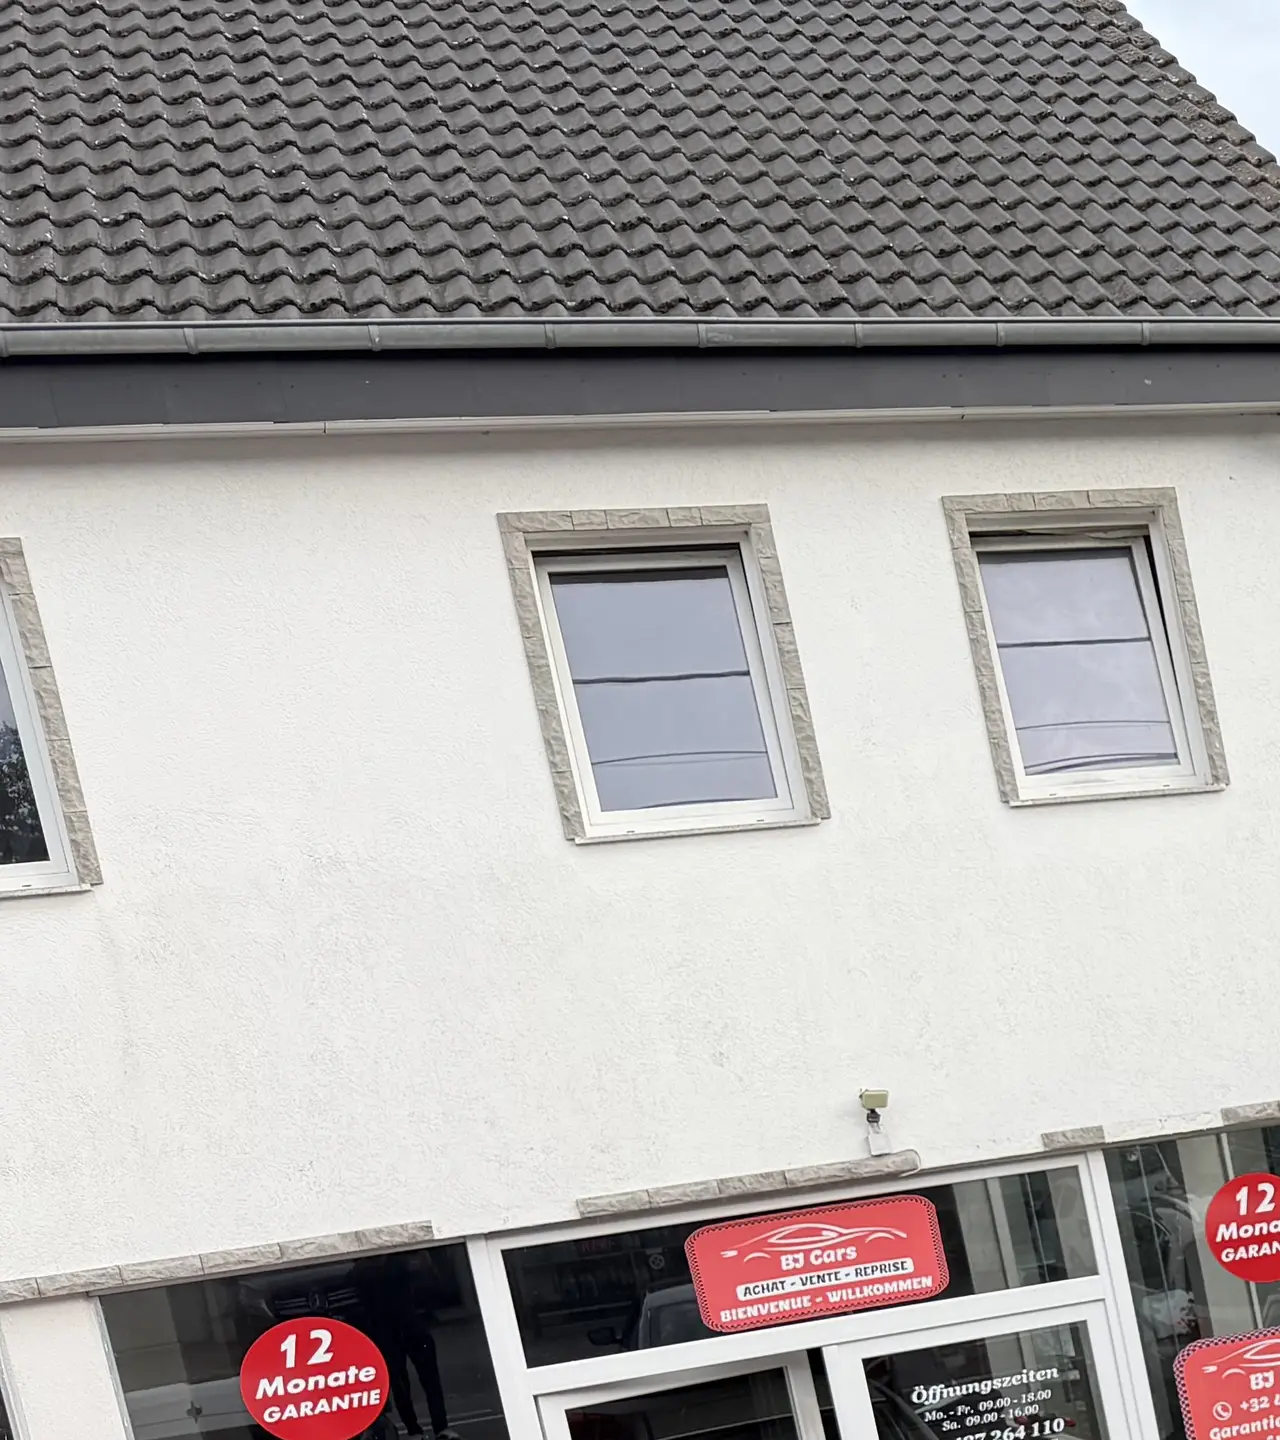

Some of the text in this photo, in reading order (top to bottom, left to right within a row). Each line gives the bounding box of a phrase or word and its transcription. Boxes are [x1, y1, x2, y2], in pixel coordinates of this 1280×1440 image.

[1236, 1182, 1276, 1216] 12
[780, 1246, 857, 1271] BJ Cars
[743, 1280, 786, 1298] ACHAT
[800, 1270, 841, 1287] VENTE
[854, 1260, 908, 1278] REPRISE
[720, 1295, 812, 1323] BIENVENUE
[826, 1275, 933, 1304] WILLKOMMEN
[280, 1328, 334, 1368] 12
[256, 1365, 377, 1400] Monate
[911, 1366, 1060, 1405] Öffnungszeiten
[1250, 1370, 1274, 1390] BJ
[264, 1388, 381, 1423] GARANTIE
[924, 1410, 946, 1422] Mo.
[956, 1405, 974, 1416] Fr.
[979, 1397, 1010, 1412] 09.00
[1020, 1389, 1052, 1403] 18.00
[942, 1420, 961, 1432] Sa.
[966, 1412, 998, 1426] 09.00
[1008, 1404, 1040, 1418] 16.00
[1240, 1396, 1270, 1412] +32
[1030, 1418, 1065, 1438] 110
